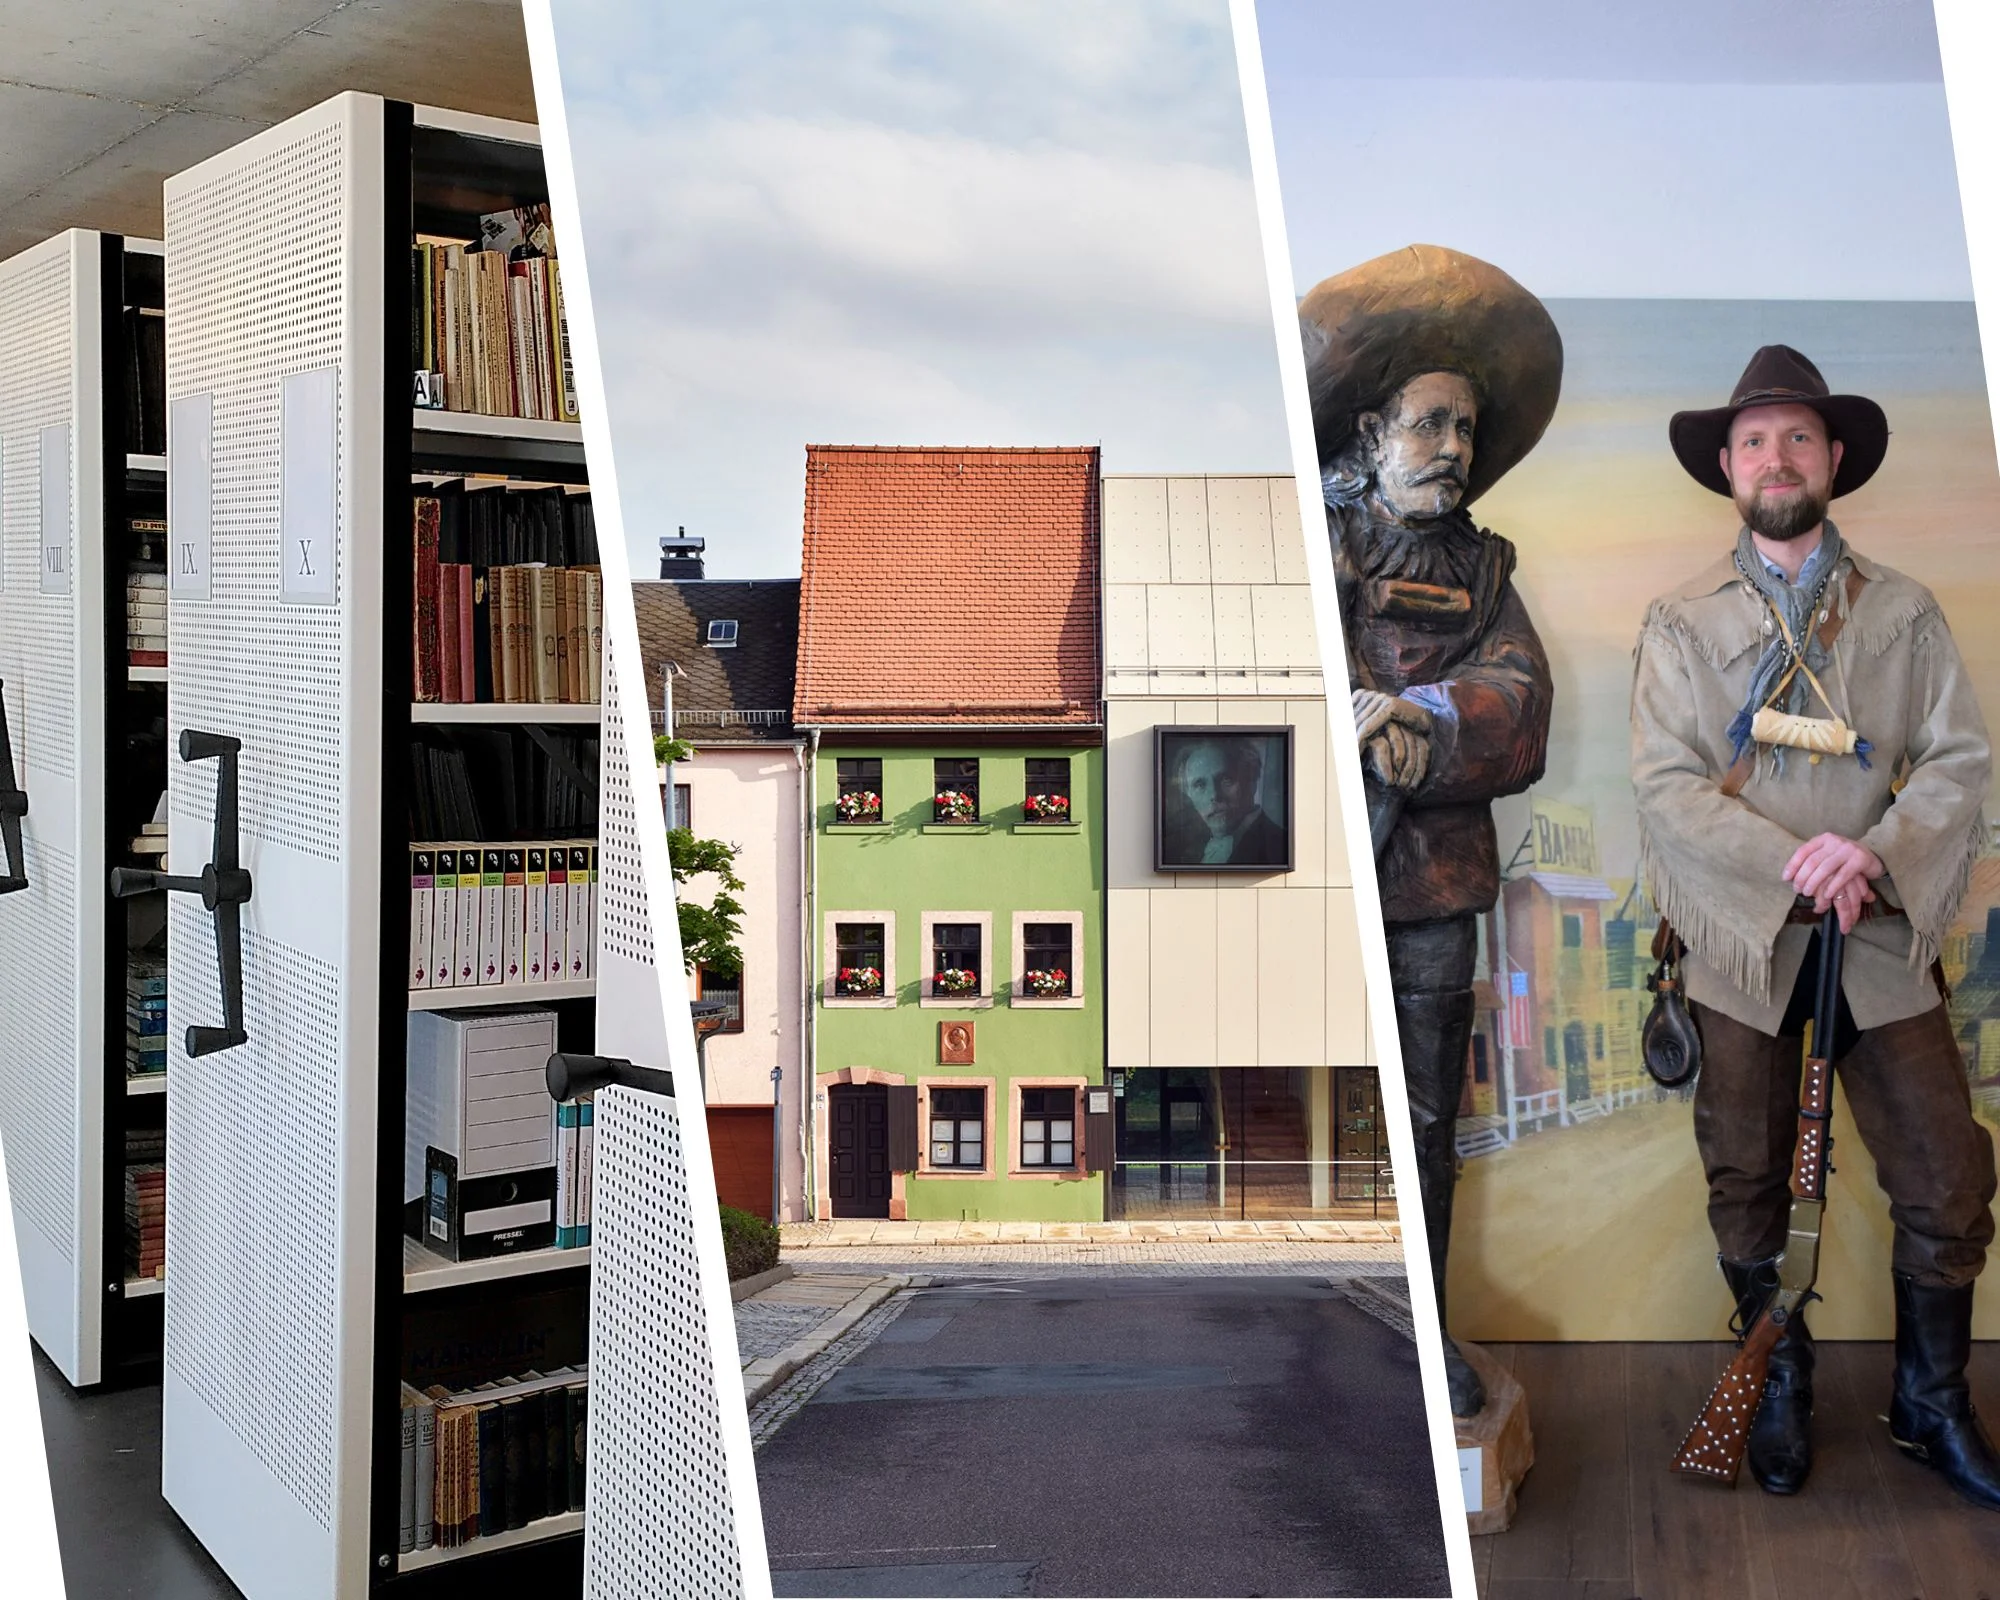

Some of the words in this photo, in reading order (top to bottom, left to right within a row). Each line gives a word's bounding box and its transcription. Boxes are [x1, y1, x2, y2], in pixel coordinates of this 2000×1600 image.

[413, 375, 427, 401] A
[431, 390, 440, 407] A
[46, 547, 64, 573] VIII.
[181, 543, 198, 574] IX.
[299, 539, 316, 576] X.
[1535, 814, 1592, 871] BANK
